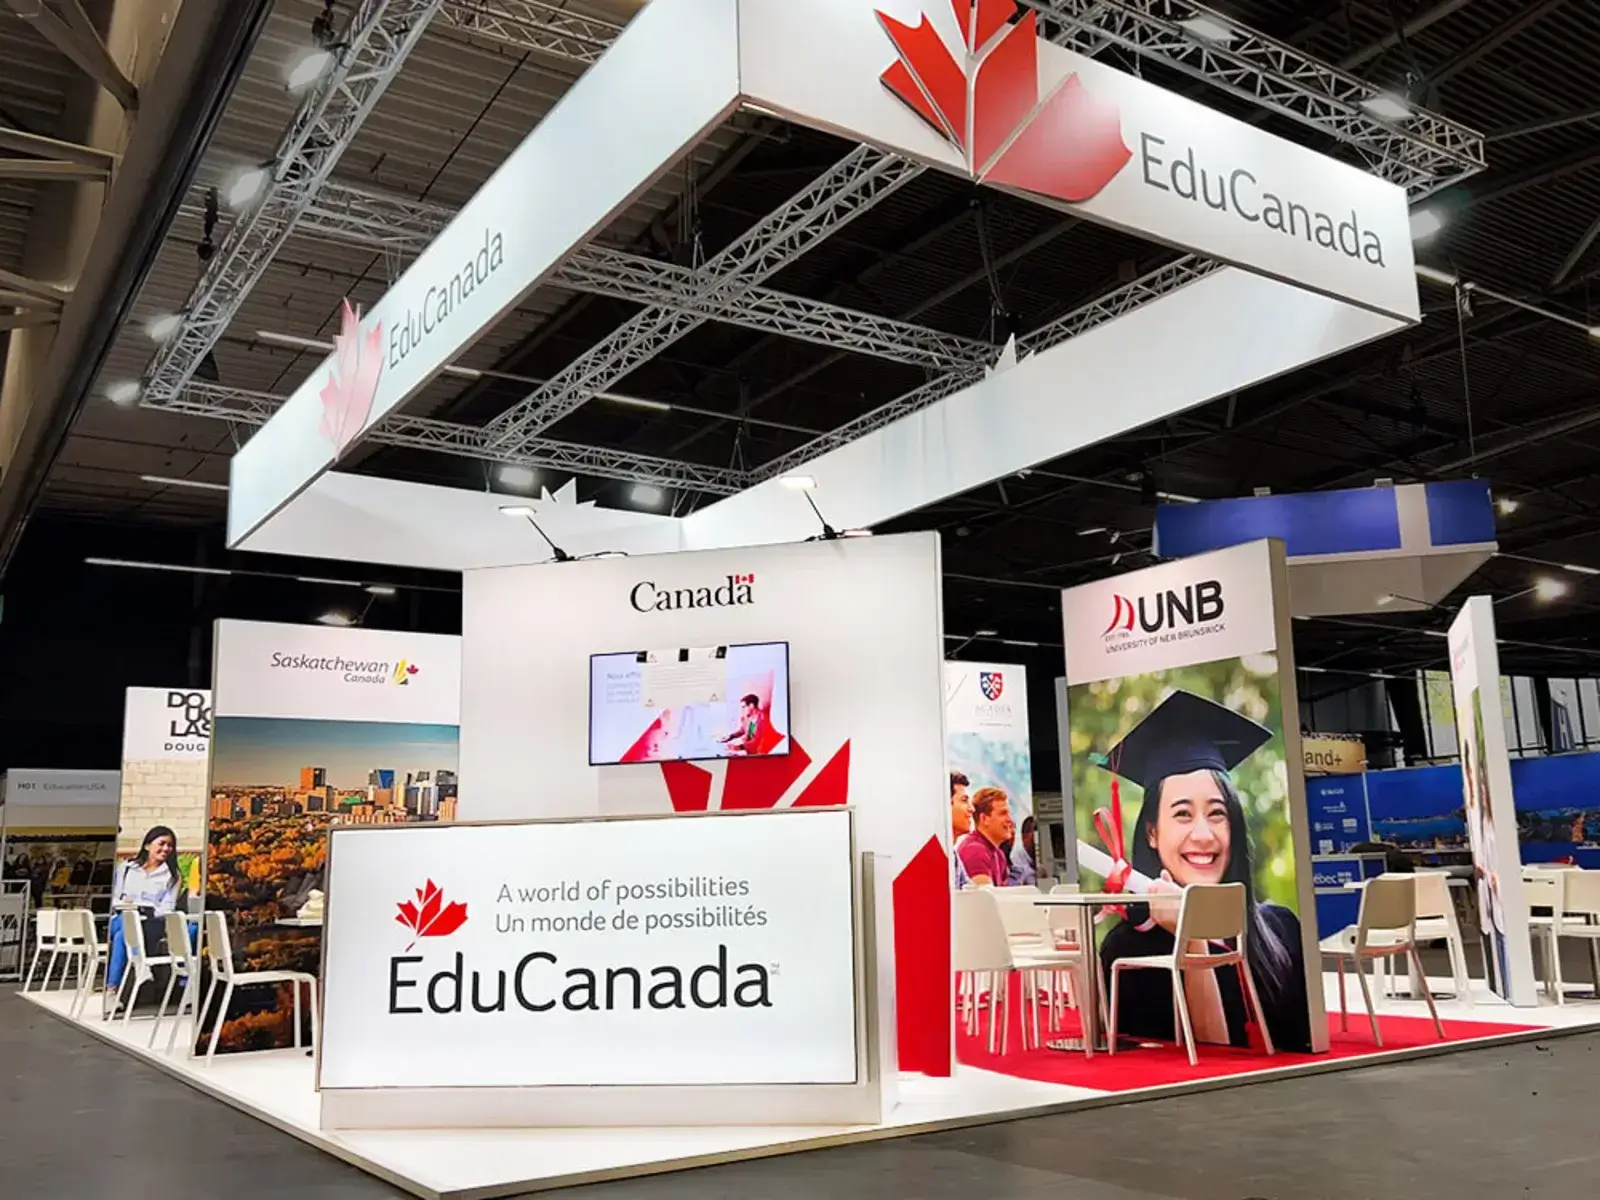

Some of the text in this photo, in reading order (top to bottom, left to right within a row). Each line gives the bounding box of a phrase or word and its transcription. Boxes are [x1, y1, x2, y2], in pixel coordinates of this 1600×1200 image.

[1140, 131, 1386, 268] EduCanada
[389, 227, 504, 370] EduCanada
[629, 574, 755, 613] Canada
[1138, 580, 1224, 634] UNB
[1105, 623, 1226, 654] UNIVERSITY OF NEW BRUNSWICK
[270, 651, 390, 674] Saskatchewan
[343, 672, 386, 685] Canada
[496, 876, 750, 905] A world of possibilities
[495, 904, 768, 935] Un monde de possibilités
[388, 944, 774, 1015] EduCanada
